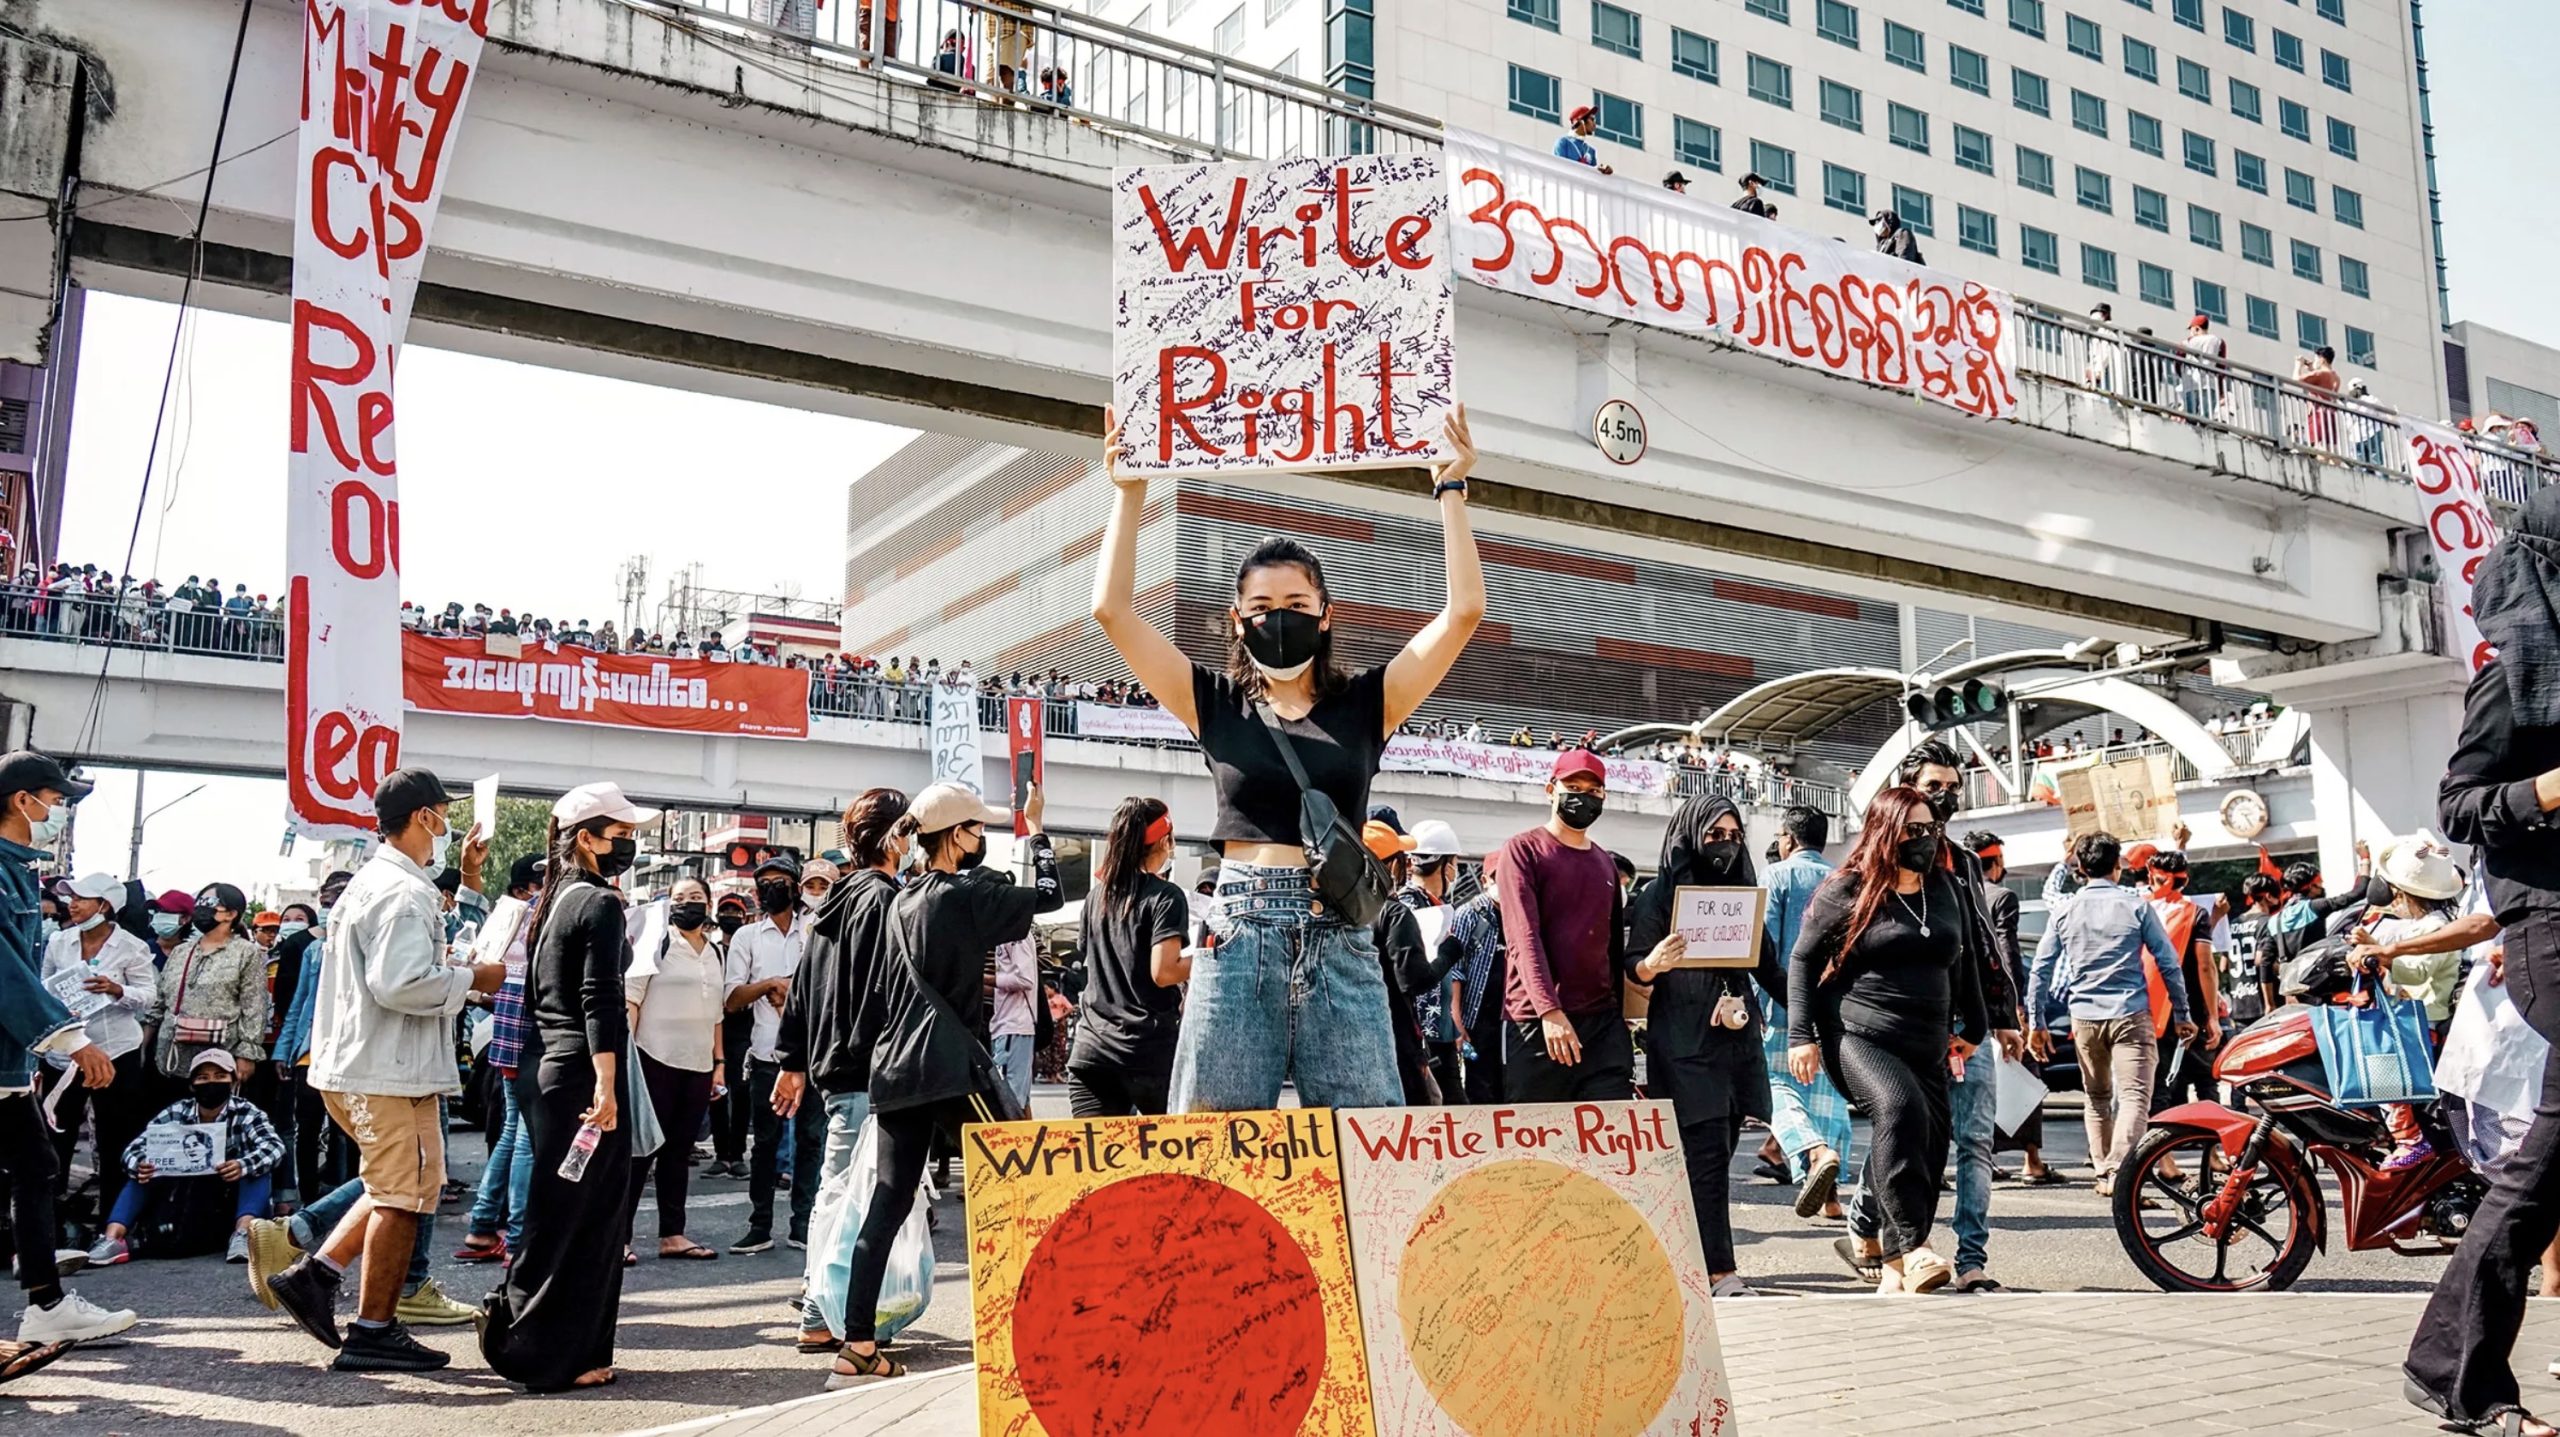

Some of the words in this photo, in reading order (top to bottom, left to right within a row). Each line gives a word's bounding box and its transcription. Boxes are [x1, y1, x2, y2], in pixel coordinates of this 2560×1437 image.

[1138, 168, 1434, 273] Write
[1241, 279, 1360, 332] For
[1159, 341, 1429, 463] Right
[1600, 417, 1642, 445] 4.5m
[1697, 900, 1716, 916] FOR
[1721, 901, 1743, 917] OUR
[148, 1157, 176, 1166] FREE
[970, 1122, 1127, 1177] Write
[1138, 1122, 1211, 1161] For
[1229, 1112, 1334, 1182] Right
[1348, 1112, 1487, 1162] Write
[1493, 1109, 1563, 1149] For
[1574, 1104, 1676, 1176] Right
